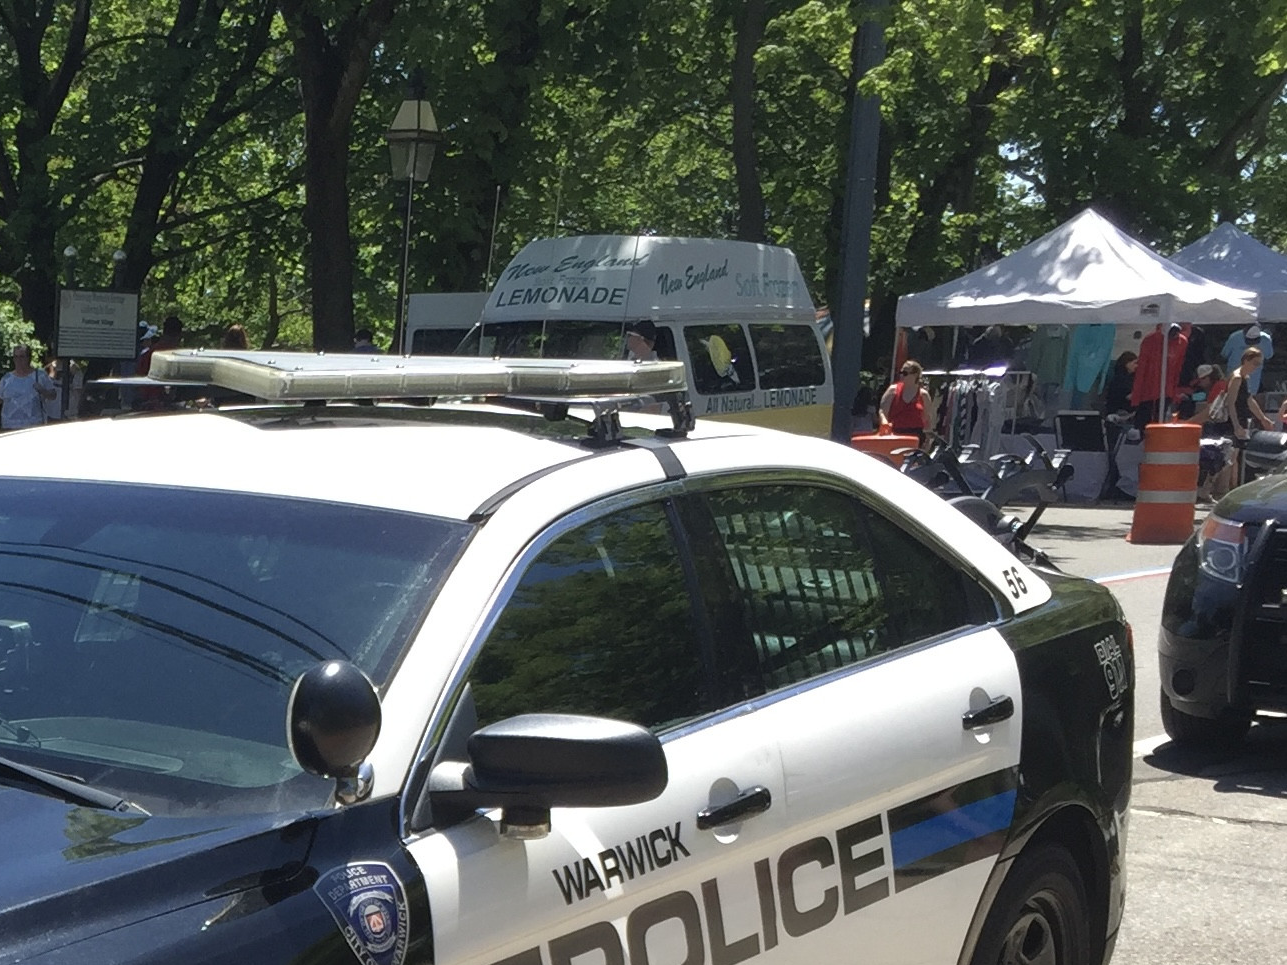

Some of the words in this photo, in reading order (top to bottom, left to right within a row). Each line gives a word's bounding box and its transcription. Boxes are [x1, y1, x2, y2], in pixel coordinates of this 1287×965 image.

[507, 263, 550, 281] New
[553, 253, 650, 274] England
[657, 273, 683, 296] New
[685, 258, 729, 291] England
[495, 286, 626, 308] LEMONADE
[735, 272, 760, 297] Soft
[705, 397, 719, 413] All
[764, 387, 817, 408] LEMONADE
[1002, 566, 1028, 599] 56
[330, 866, 367, 884] POLICE
[552, 821, 691, 905] WARWICK
[344, 926, 367, 957] CITY
